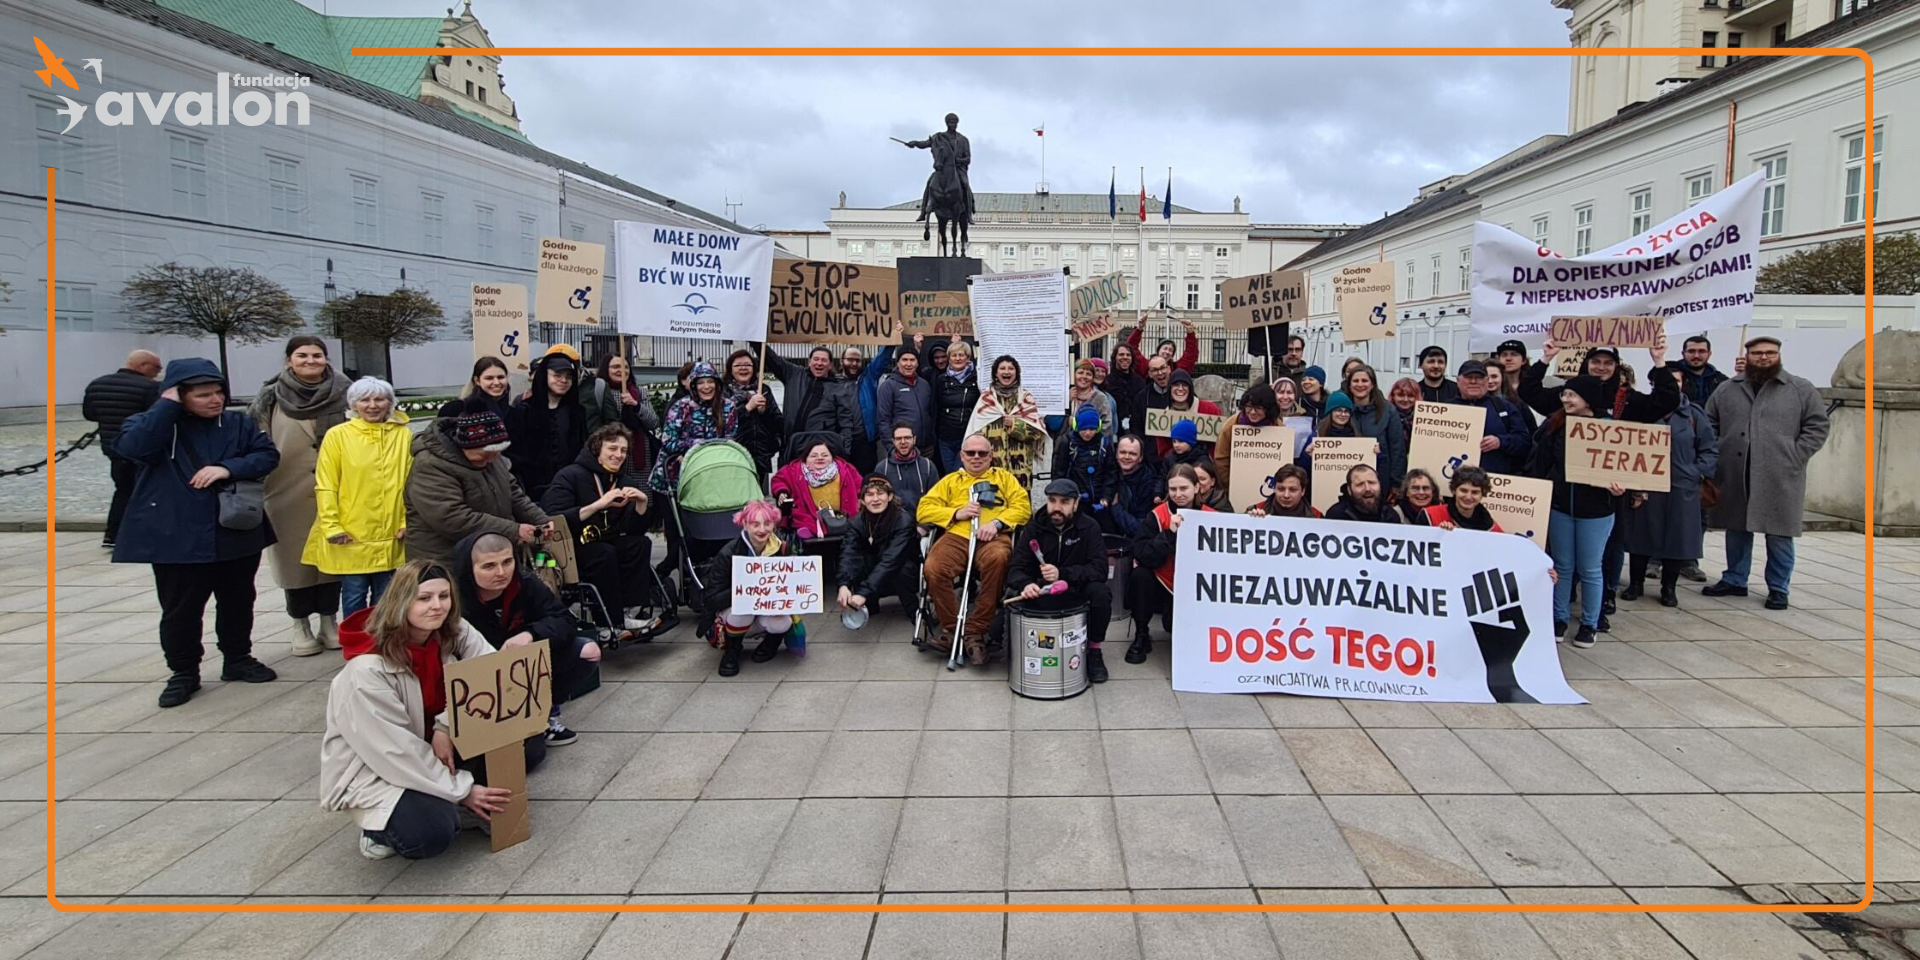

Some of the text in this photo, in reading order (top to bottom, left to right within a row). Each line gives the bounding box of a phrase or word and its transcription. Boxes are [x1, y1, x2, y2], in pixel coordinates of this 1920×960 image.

[1647, 211, 1717, 251] ŻYCIA
[542, 240, 577, 251] Godne
[653, 228, 740, 251] MAŁE DOMY
[541, 251, 569, 261] życie
[1513, 224, 1741, 284] DLA OPIEKUNEK OSÓB
[541, 261, 556, 270] dla
[671, 251, 722, 273] MUSZĄ
[787, 261, 860, 289] STOP
[1343, 267, 1372, 276] Godne
[639, 267, 751, 291] BYĆ W USTAWIE
[1343, 276, 1366, 285] życie
[474, 285, 502, 295] Godne
[1343, 286, 1356, 294] dla
[474, 297, 496, 307] życie
[769, 285, 890, 315] STEMOWEMU
[904, 293, 937, 305] NAWET
[1229, 293, 1257, 308] DLA
[1505, 291, 1515, 305] Z
[475, 309, 486, 318] dla
[770, 309, 892, 338] EWOLNICTWU
[908, 319, 927, 328] MA
[670, 326, 721, 335] Autyzm Polska
[1551, 318, 1661, 346] CZAS NA ZMIANY
[1557, 365, 1578, 373] KAL
[1417, 404, 1448, 415] STOP
[1415, 416, 1471, 431] przemocy
[1234, 428, 1261, 437] STOP
[1414, 426, 1470, 442] finansowej
[1569, 422, 1671, 446] ASYSTENT
[1233, 440, 1283, 450] przemocy
[1314, 440, 1342, 449] STOP
[1233, 450, 1282, 461] finansowej
[1314, 452, 1364, 462] przemocy
[1586, 448, 1665, 475] TERAZ
[1314, 463, 1355, 471] finansow
[1490, 476, 1512, 487] TOP
[1483, 502, 1535, 518] nansowej
[1197, 525, 1442, 568] NIEPEDAGOGICZNE
[759, 574, 787, 586] OZN
[796, 585, 813, 595] NIE
[1195, 569, 1448, 617] NIEZAUWAŻALNE
[1209, 617, 1437, 678] DOŚĆ TEGO!
[1237, 672, 1429, 696] OZZ INICJATYWA PRACOWNICZA
